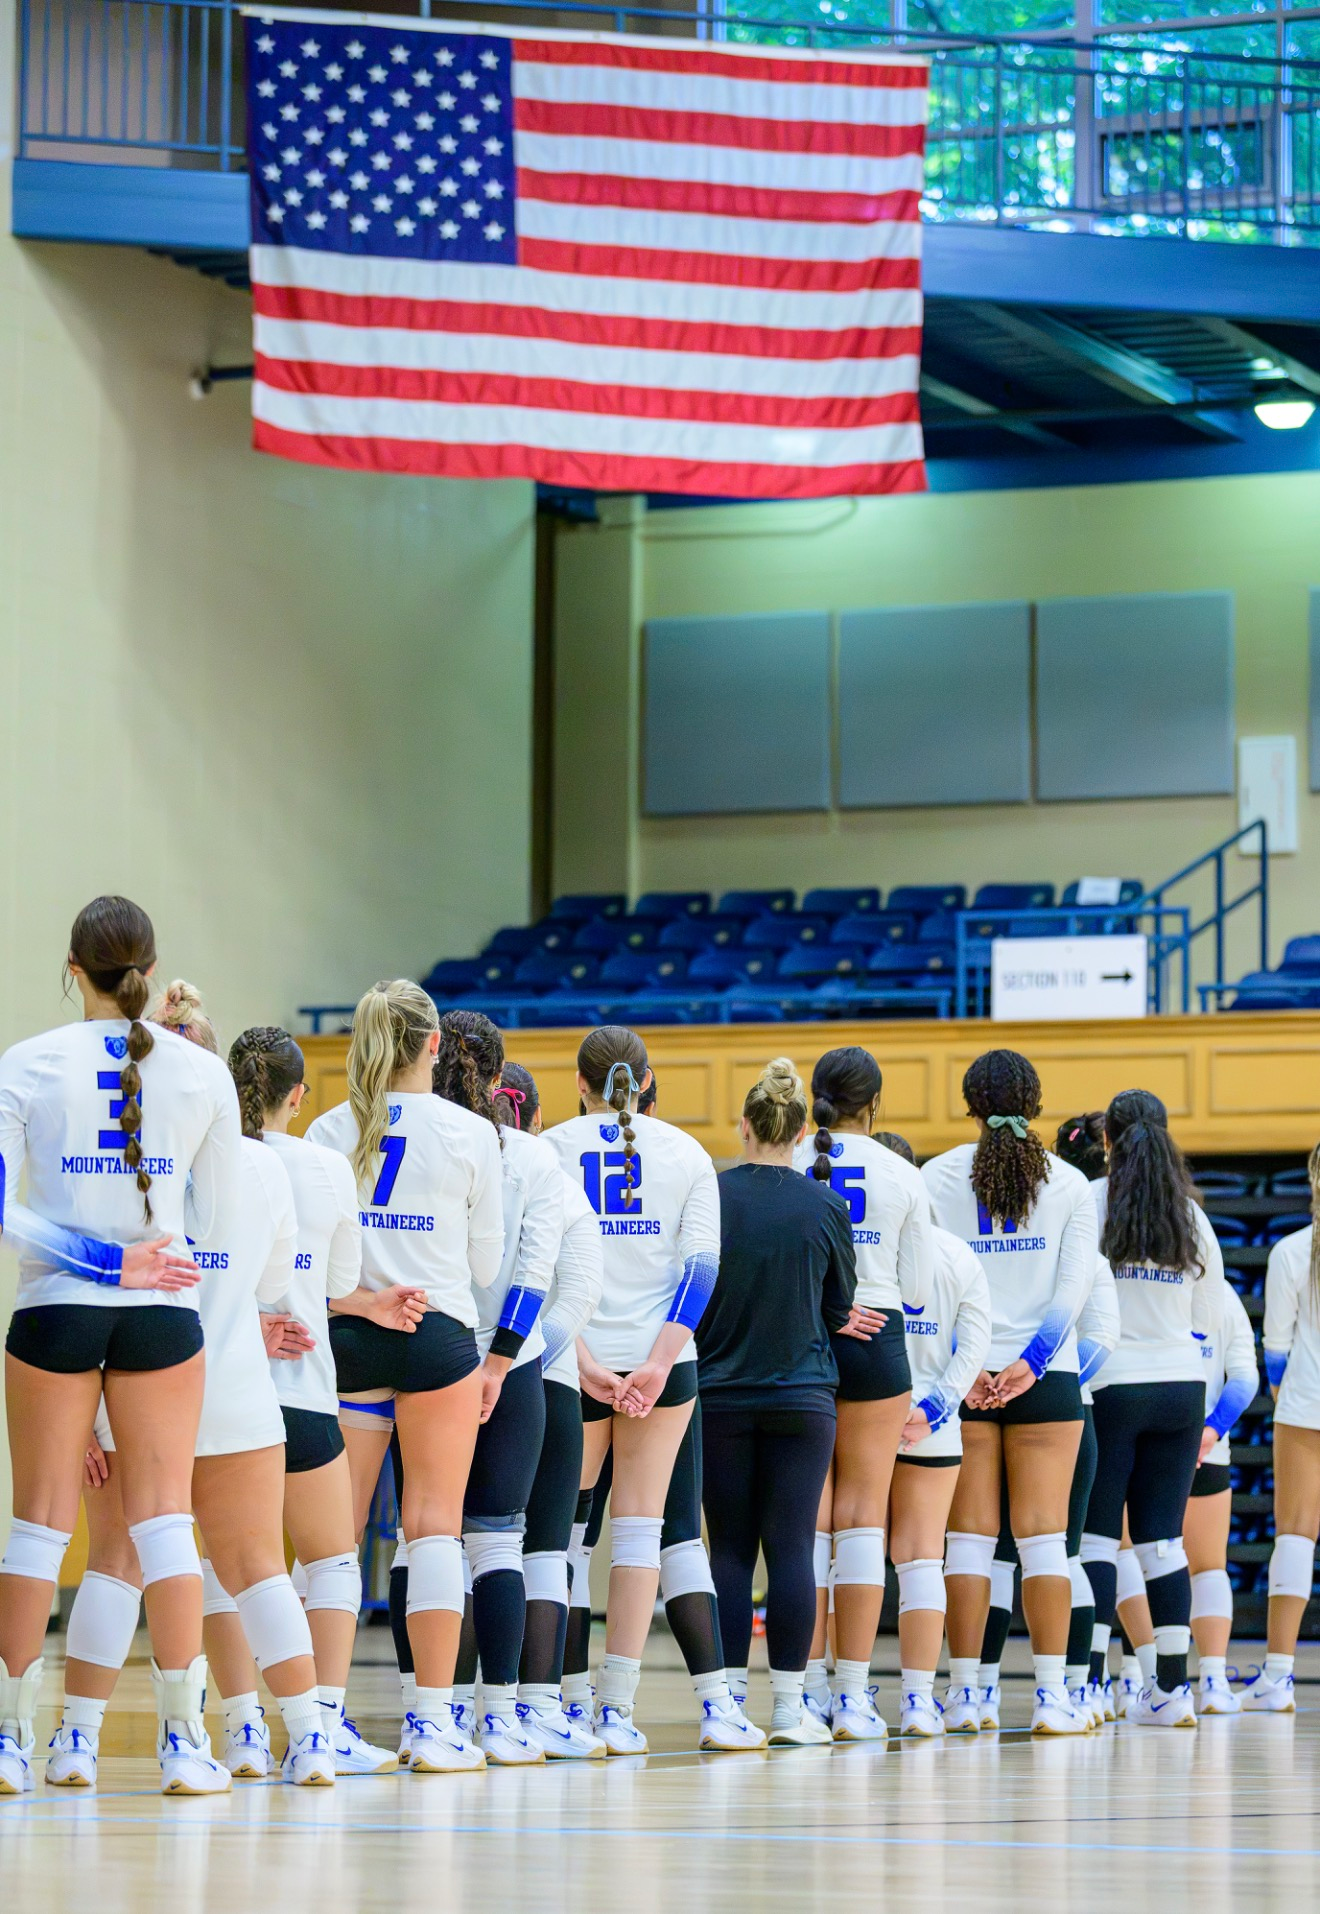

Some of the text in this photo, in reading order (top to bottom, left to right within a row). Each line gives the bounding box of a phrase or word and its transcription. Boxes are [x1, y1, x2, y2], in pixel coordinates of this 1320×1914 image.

[1002, 970, 1058, 989] SECTION
[97, 1071, 142, 1149] 3
[580, 1152, 642, 1215] 12
[806, 1166, 866, 1224] 5
